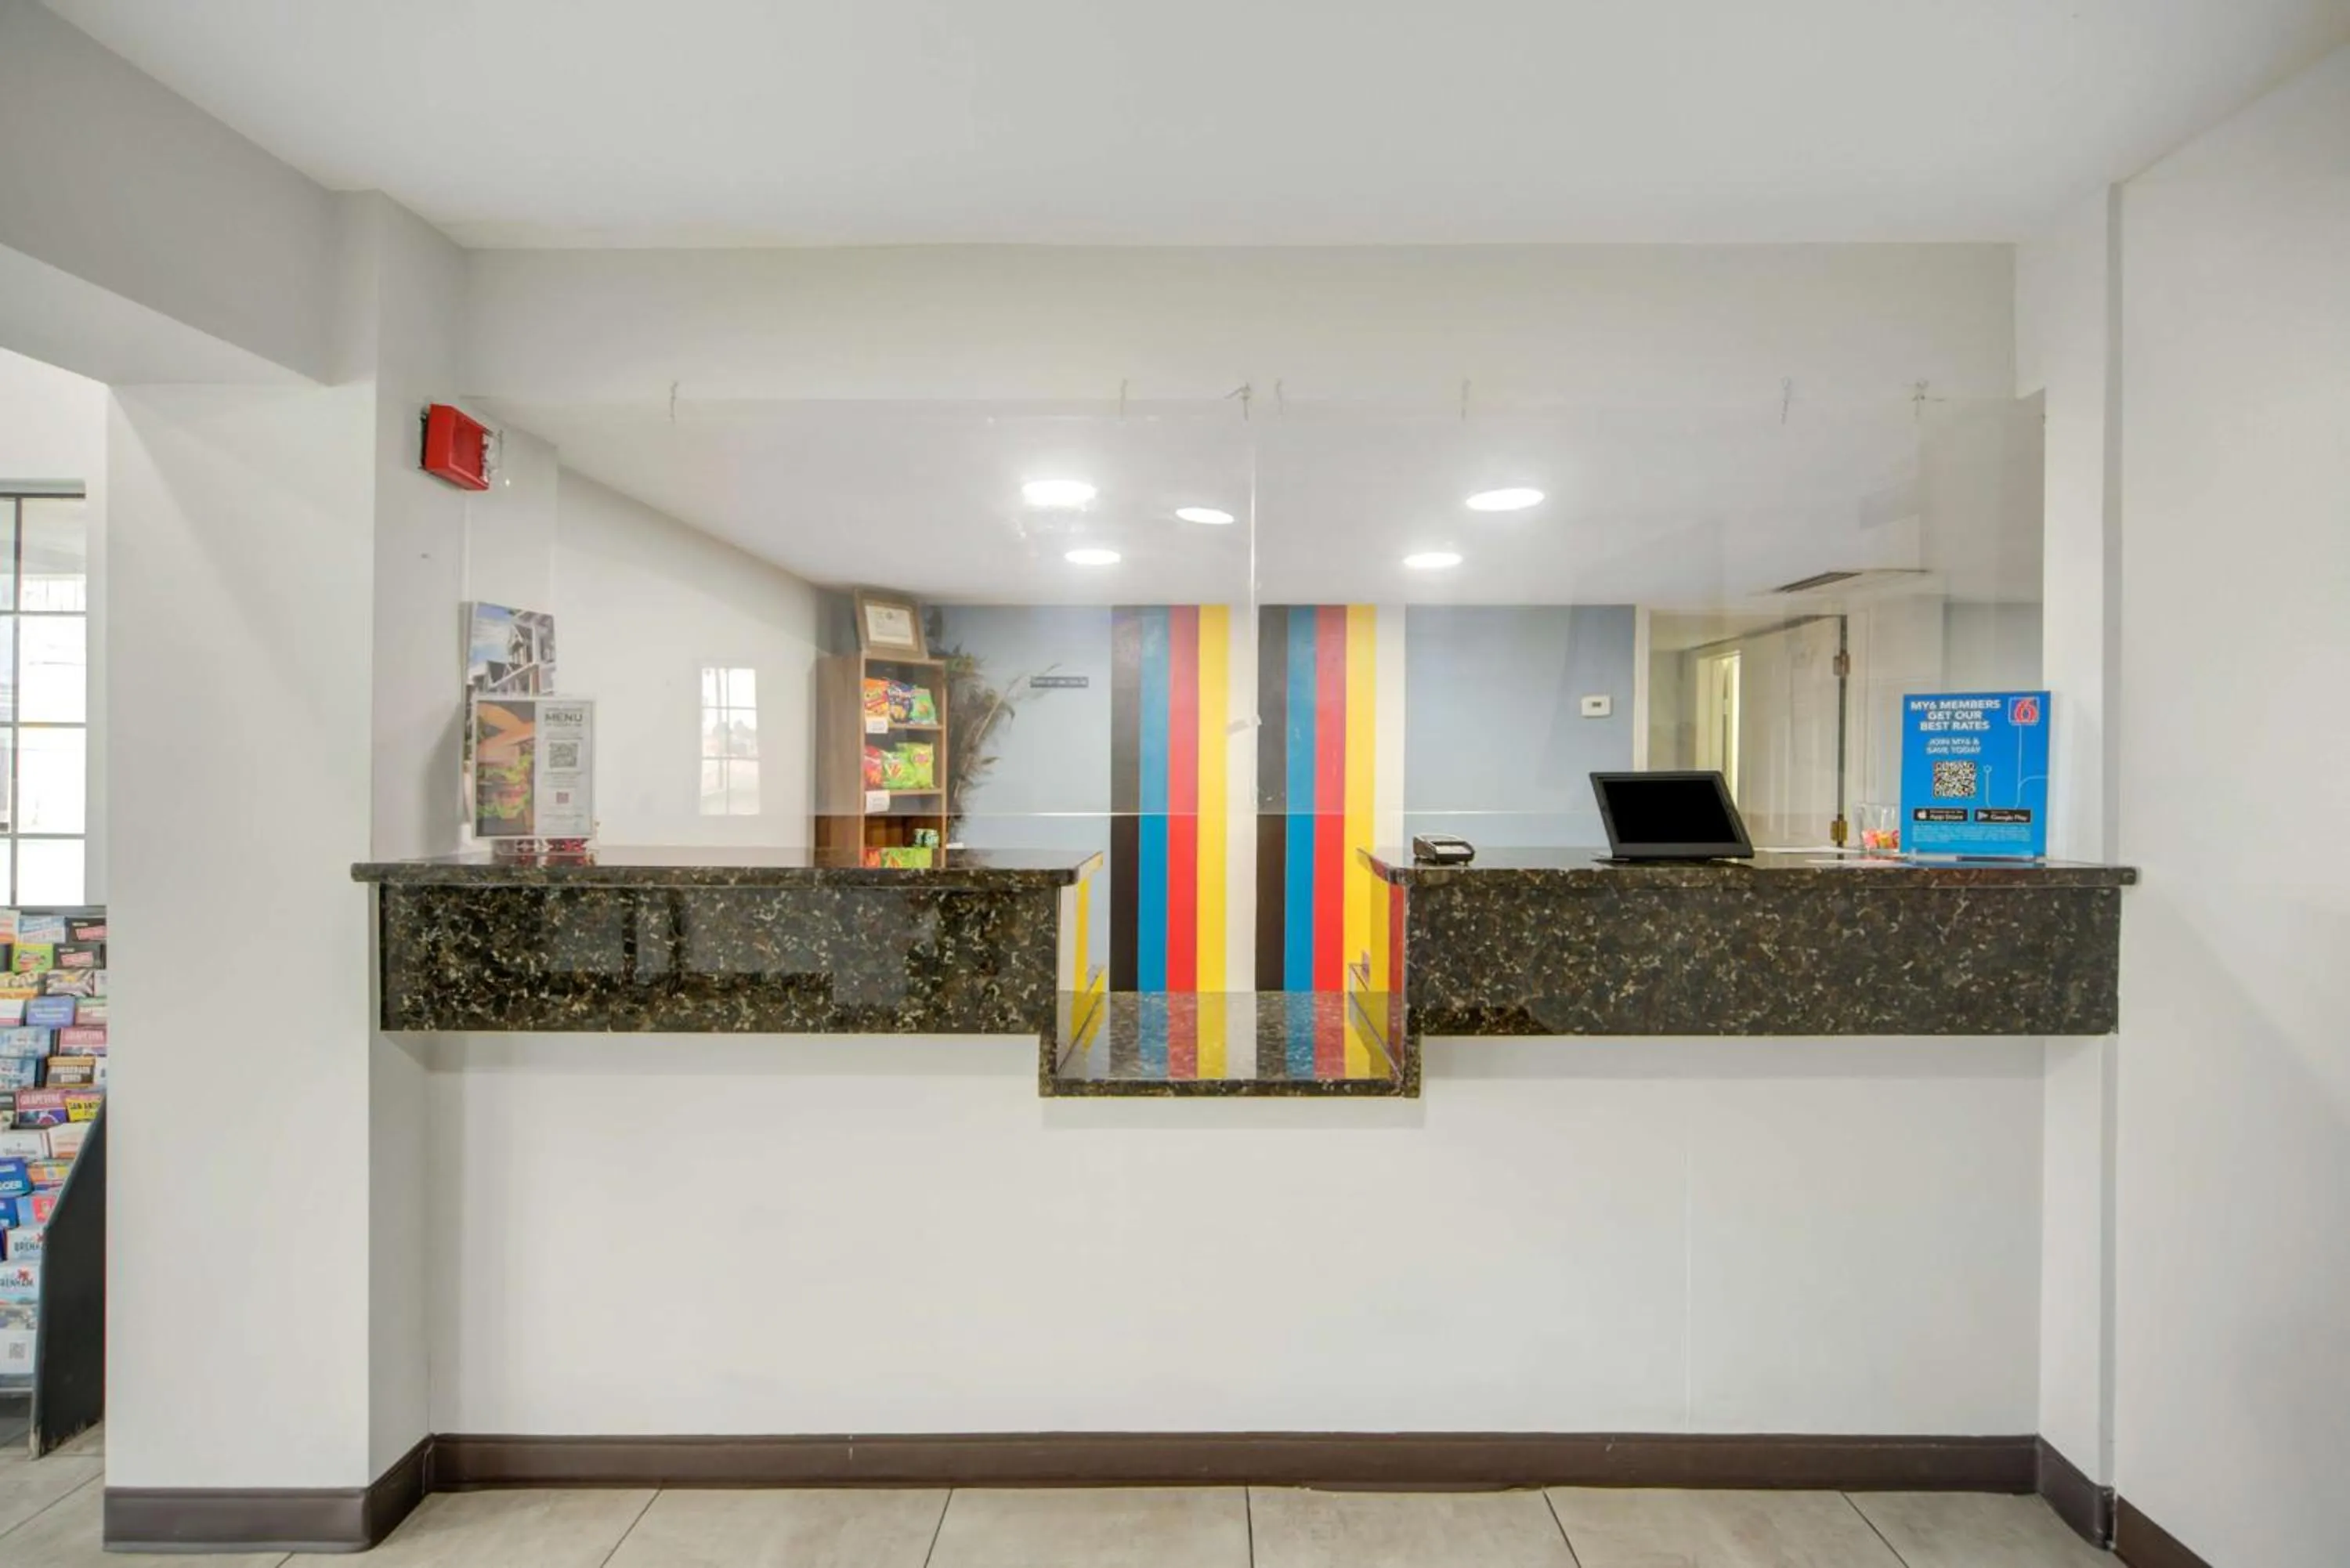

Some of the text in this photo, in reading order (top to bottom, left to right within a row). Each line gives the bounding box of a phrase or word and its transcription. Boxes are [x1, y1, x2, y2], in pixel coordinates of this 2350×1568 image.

[1911, 699, 2001, 710] MY6 MEMBERS
[544, 712, 583, 722] MENU
[1928, 710, 1983, 720] GET OUR
[1920, 721, 1990, 731] BEST RATES
[20, 1093, 61, 1106] GRAPEVINE
